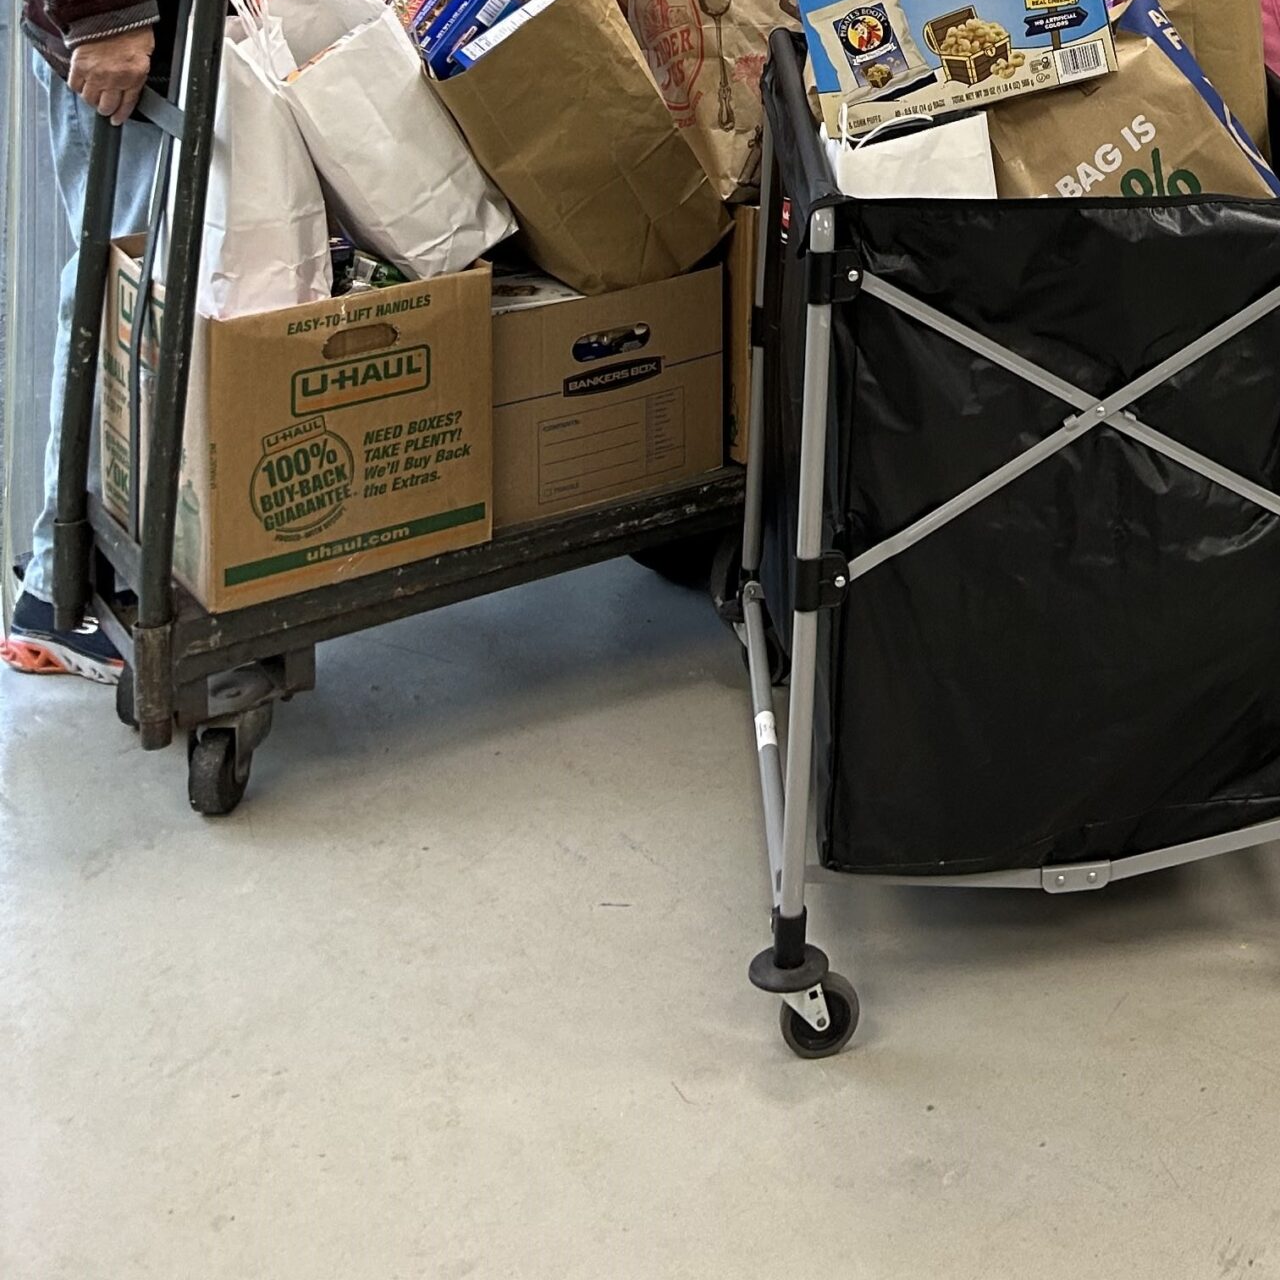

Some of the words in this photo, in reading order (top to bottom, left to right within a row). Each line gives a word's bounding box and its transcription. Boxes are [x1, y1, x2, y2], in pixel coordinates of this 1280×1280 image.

[1054, 143, 1122, 198] BAG
[1120, 114, 1156, 152] IS
[287, 306, 373, 336] EASY-TO-LIFT
[375, 294, 431, 317] HANDLES
[302, 352, 422, 398] U-HAUL
[568, 368, 629, 391] BANKERS
[630, 360, 658, 378] BOX
[265, 421, 322, 448] U-HAUL
[363, 424, 403, 447] NEED
[407, 410, 463, 436] BOXES?
[363, 442, 401, 464] TAKE
[403, 427, 463, 454] PLENTY!
[261, 438, 338, 489] 100%
[364, 461, 400, 481] We'll
[403, 455, 432, 472] Buy
[435, 443, 472, 464] Back
[259, 463, 348, 514] BUY-BACK
[363, 482, 388, 499] the
[391, 470, 442, 492] Extras.
[263, 482, 352, 532] GUARANTEE
[305, 525, 410, 564] uhaul.com
